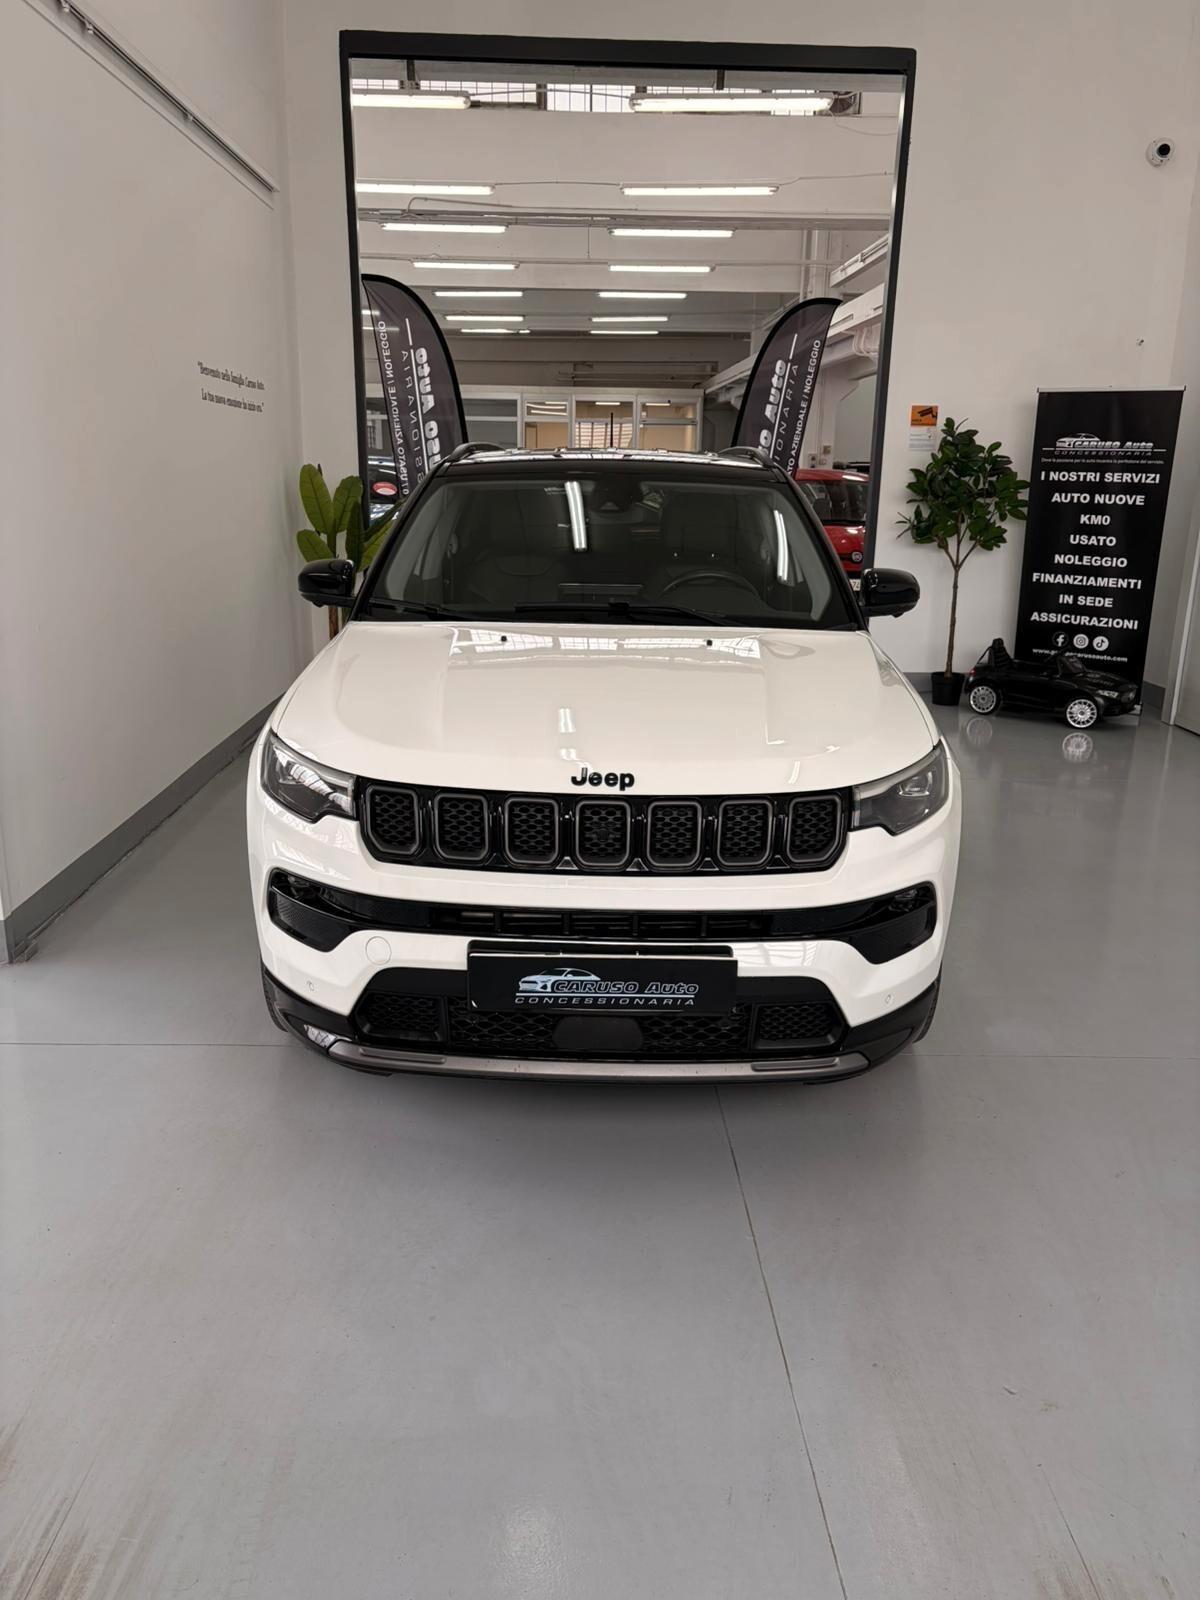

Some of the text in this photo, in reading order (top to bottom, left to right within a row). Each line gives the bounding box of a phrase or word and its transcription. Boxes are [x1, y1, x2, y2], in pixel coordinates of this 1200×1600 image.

[791, 400, 808, 456] AZIENDALE
[803, 340, 821, 393] NOLEGGIO
[774, 365, 799, 460] IONARIA
[1041, 471, 1160, 484] I NOSTRI SERVIZI
[1051, 493, 1145, 506] AUTO NUOVE
[1069, 534, 1117, 547] USATO
[1054, 554, 1128, 568] NOLEGGIO
[1032, 572, 1142, 590] FINANZIAMENTI
[1058, 594, 1114, 608] IN SEDE
[1030, 611, 1139, 630] ASSICURAZIONI
[571, 767, 635, 791] Jeep
[553, 981, 699, 995] CARUSO Auto
[515, 997, 696, 1006] CONCESSIONARIA
